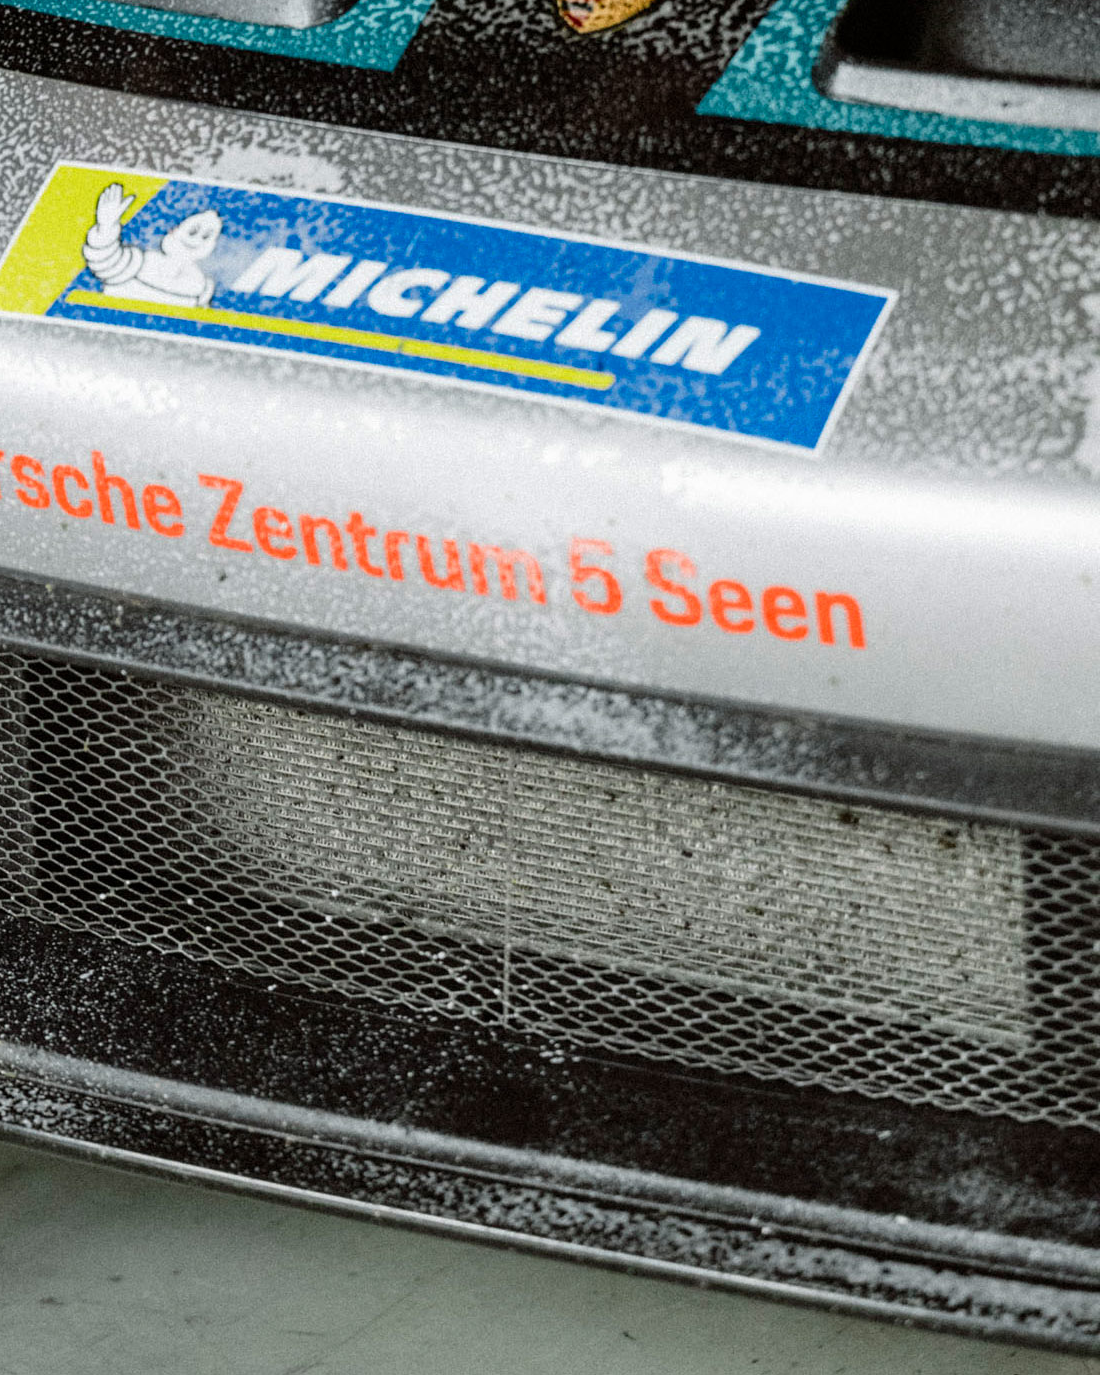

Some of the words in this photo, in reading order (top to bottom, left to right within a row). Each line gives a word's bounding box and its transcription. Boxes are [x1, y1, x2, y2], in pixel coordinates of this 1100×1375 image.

[233, 245, 761, 375] MICHELIN
[199, 473, 547, 605] Zentrum
[569, 536, 622, 614] 5
[645, 548, 867, 649] Seen
